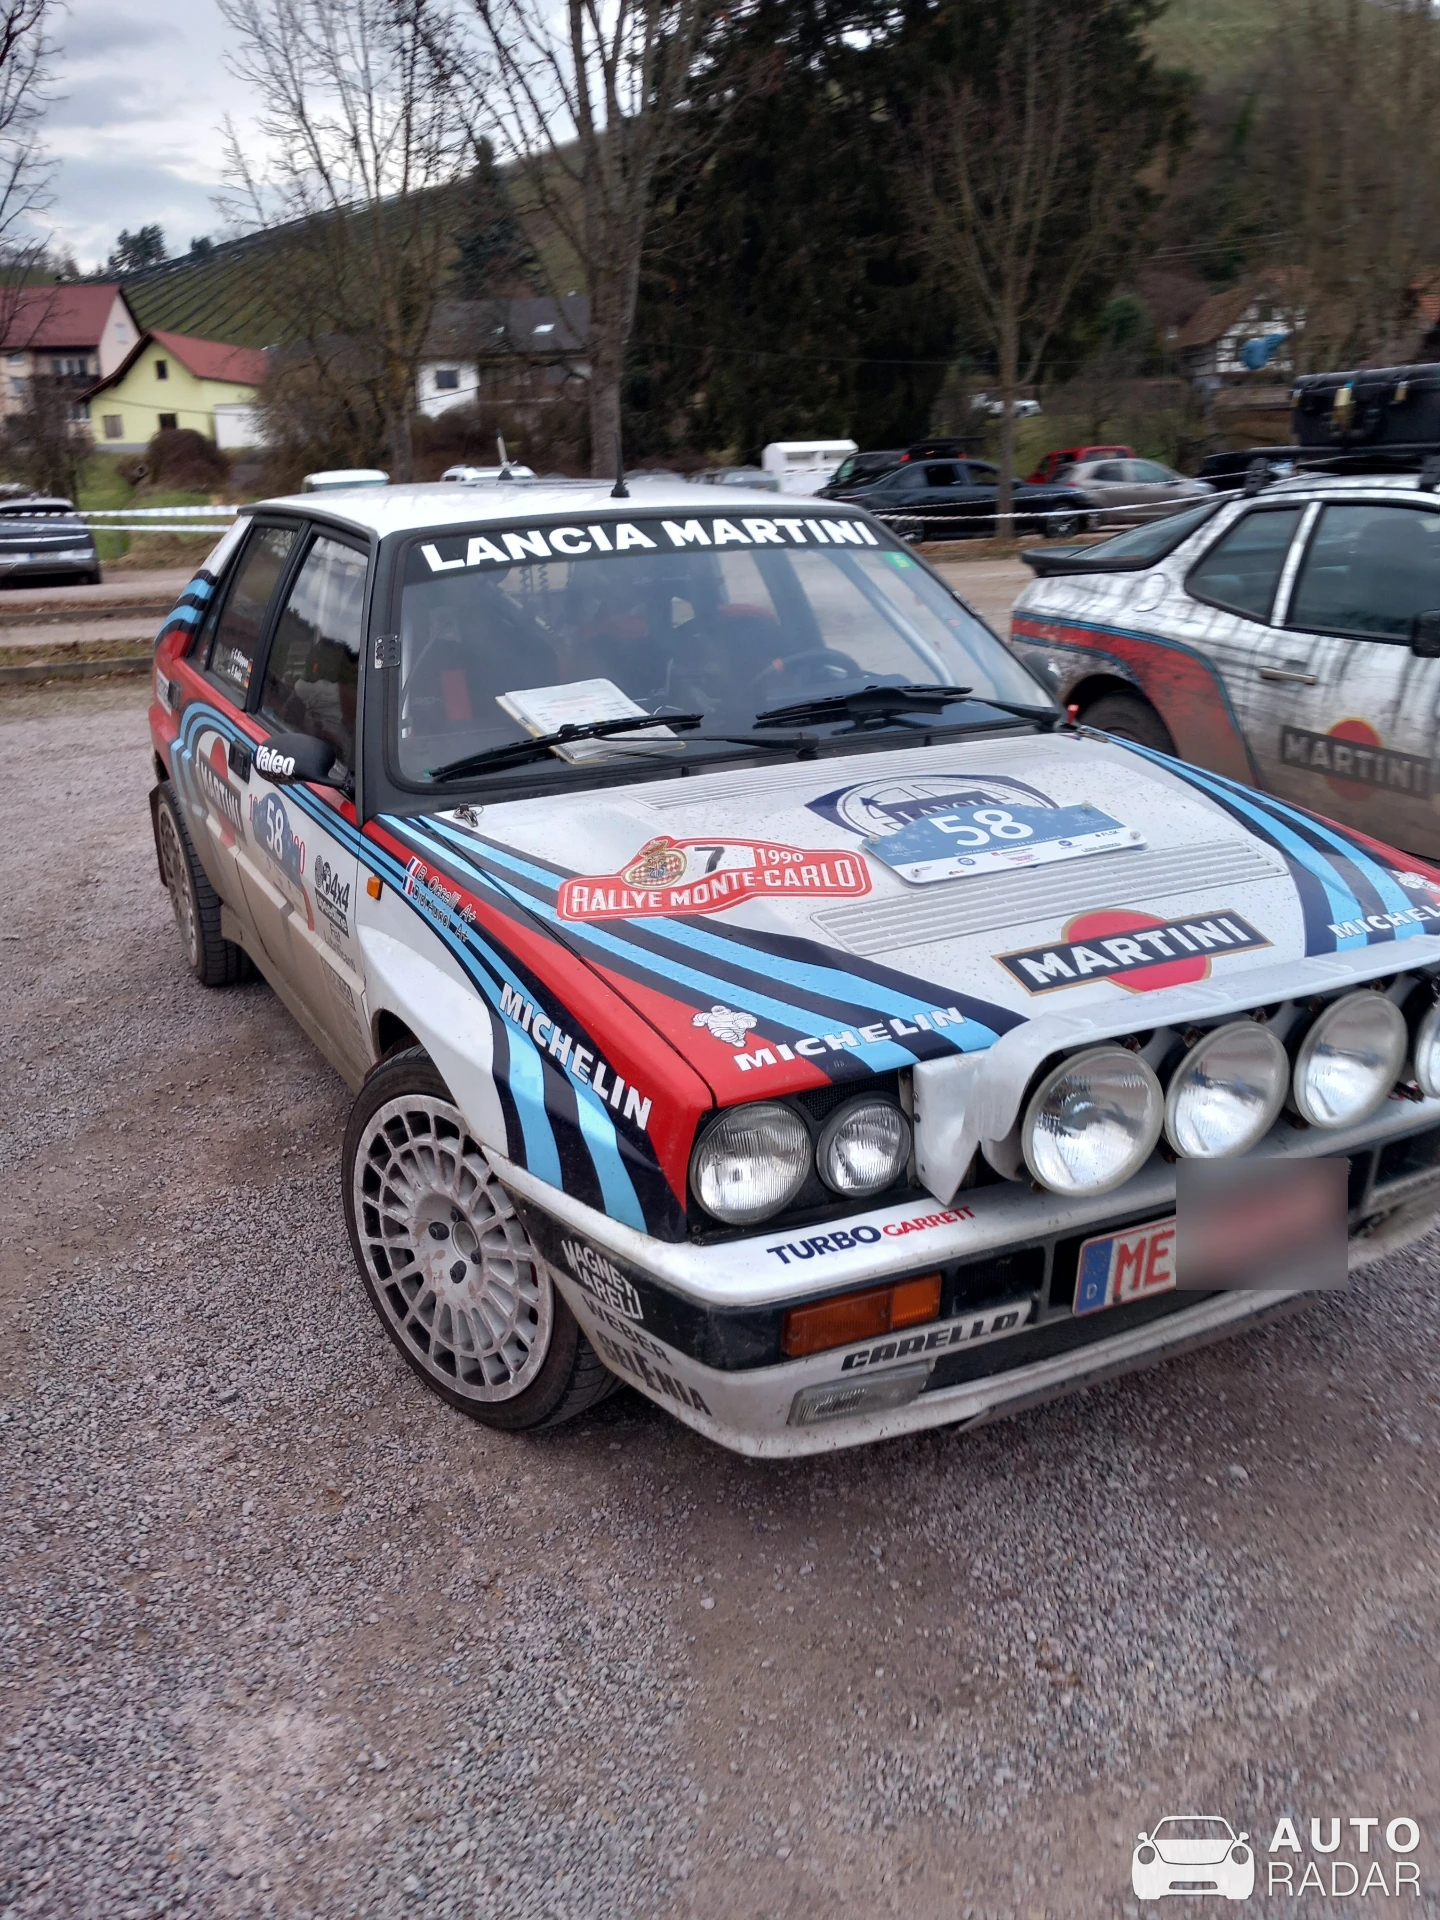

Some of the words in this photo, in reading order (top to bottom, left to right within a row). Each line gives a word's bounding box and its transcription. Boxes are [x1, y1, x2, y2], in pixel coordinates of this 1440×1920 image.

[420, 523, 657, 572] LANCIA
[661, 518, 879, 547] MARTINI
[256, 745, 295, 776] Valeo
[1284, 733, 1426, 792] MARTINI
[200, 761, 242, 831] MARTINI
[266, 798, 284, 861] 58
[757, 848, 804, 867] 1990
[928, 809, 1034, 847] 58
[416, 865, 428, 884] B.
[572, 885, 663, 913] RALLYE
[670, 859, 856, 907] MONTE-CARLO
[694, 846, 725, 874] 7
[330, 873, 351, 913] 4x4
[1326, 902, 1440, 939] MICHEL
[1018, 917, 1252, 984] MARTINI
[499, 982, 653, 1131] MICHELIN
[733, 1006, 967, 1072] MICHELIN
[766, 1225, 882, 1265] TURBO
[882, 1206, 976, 1237] GARRETT
[1112, 1229, 1175, 1300] ME
[561, 1239, 634, 1298] MAGNETI
[571, 1258, 644, 1320] MARELLI
[1086, 1282, 1098, 1300] D
[581, 1293, 673, 1366] WEBER
[840, 1311, 1020, 1372] CARELLO
[596, 1330, 713, 1417] SELENIA
